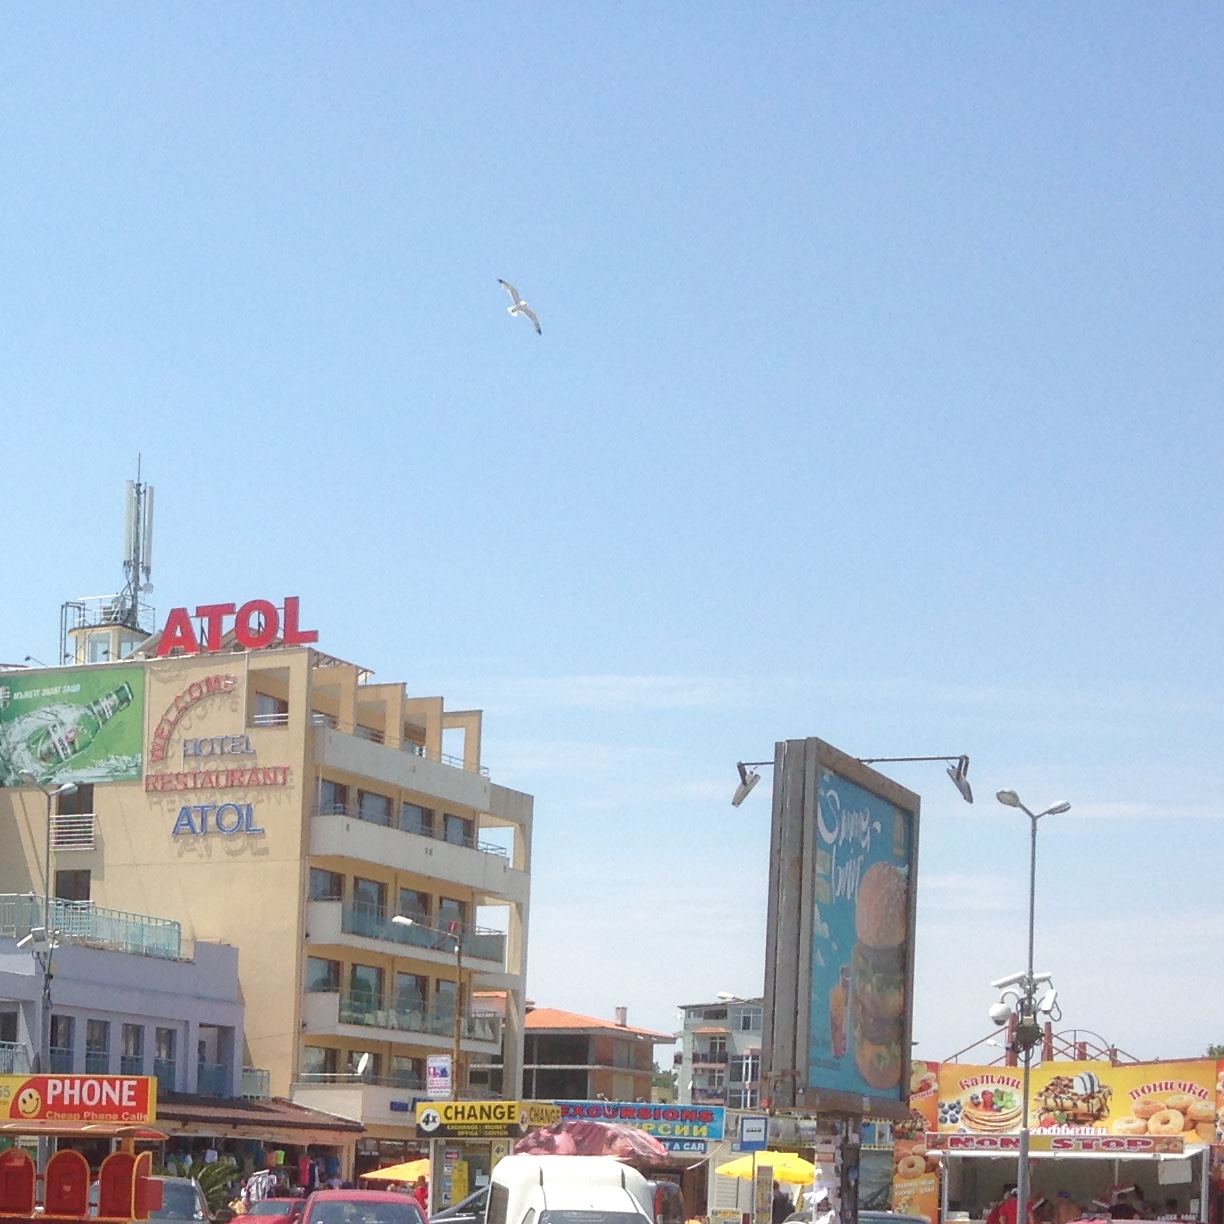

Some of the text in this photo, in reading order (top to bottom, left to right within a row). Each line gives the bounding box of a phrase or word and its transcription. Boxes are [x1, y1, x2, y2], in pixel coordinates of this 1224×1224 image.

[156, 596, 319, 658] ATOL
[150, 674, 238, 763] WELCOME
[183, 733, 256, 758] HOTEL
[145, 765, 291, 792] RESTAURANT
[172, 802, 265, 837] ATOL
[47, 1079, 138, 1107] PHONE
[45, 1110, 80, 1122] Cheap
[121, 1111, 149, 1123] Calls
[444, 1105, 516, 1120] CHANGE
[561, 1104, 715, 1123] EXCURSIONS
[683, 1142, 705, 1150] CAR
[948, 1137, 1153, 1150] NON STOP
